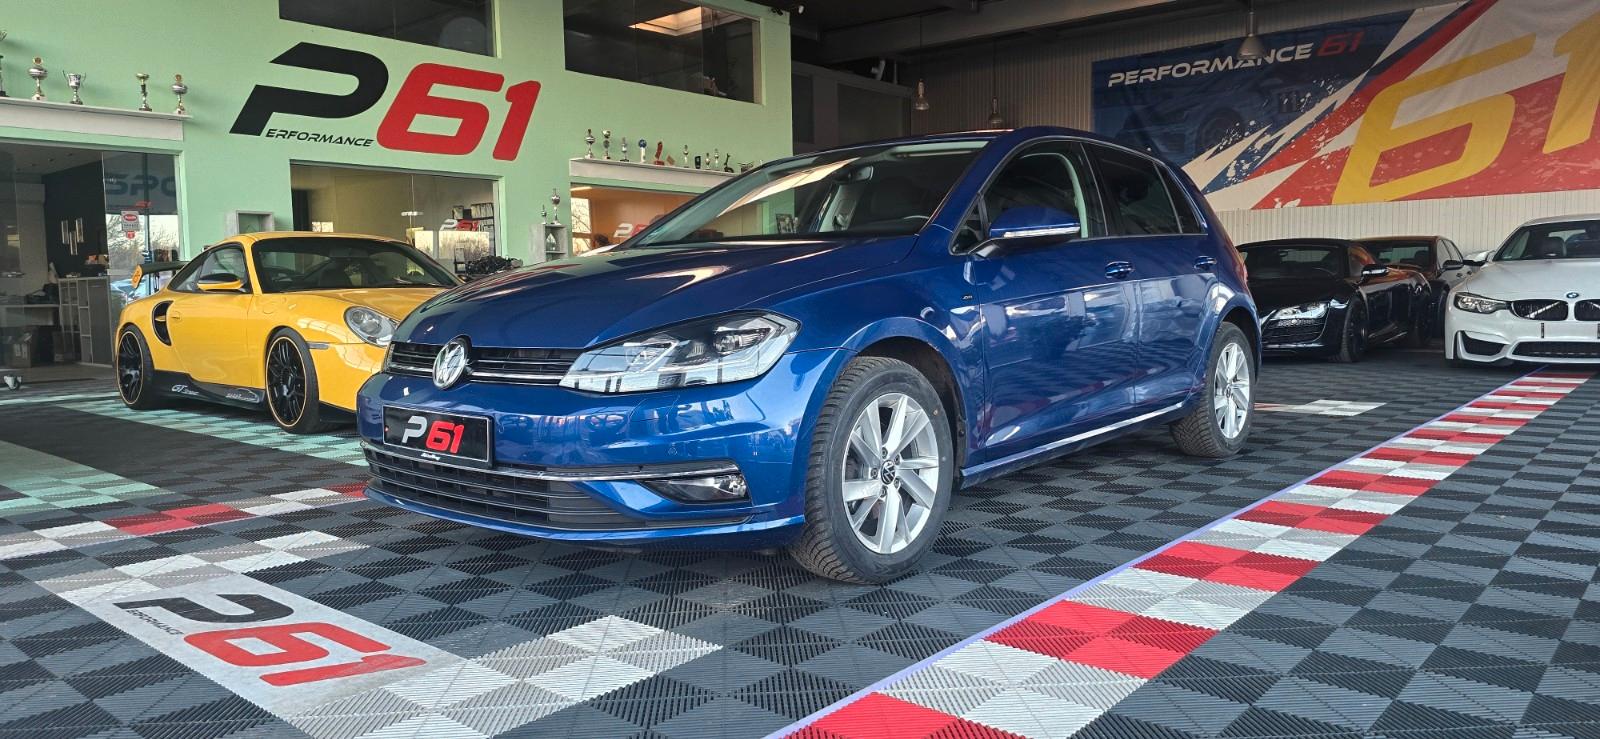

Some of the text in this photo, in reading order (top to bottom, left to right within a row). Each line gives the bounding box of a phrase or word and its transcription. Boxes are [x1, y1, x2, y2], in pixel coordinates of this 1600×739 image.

[1107, 31, 1366, 88] PERFORMANCE 61
[401, 415, 465, 454] P61
